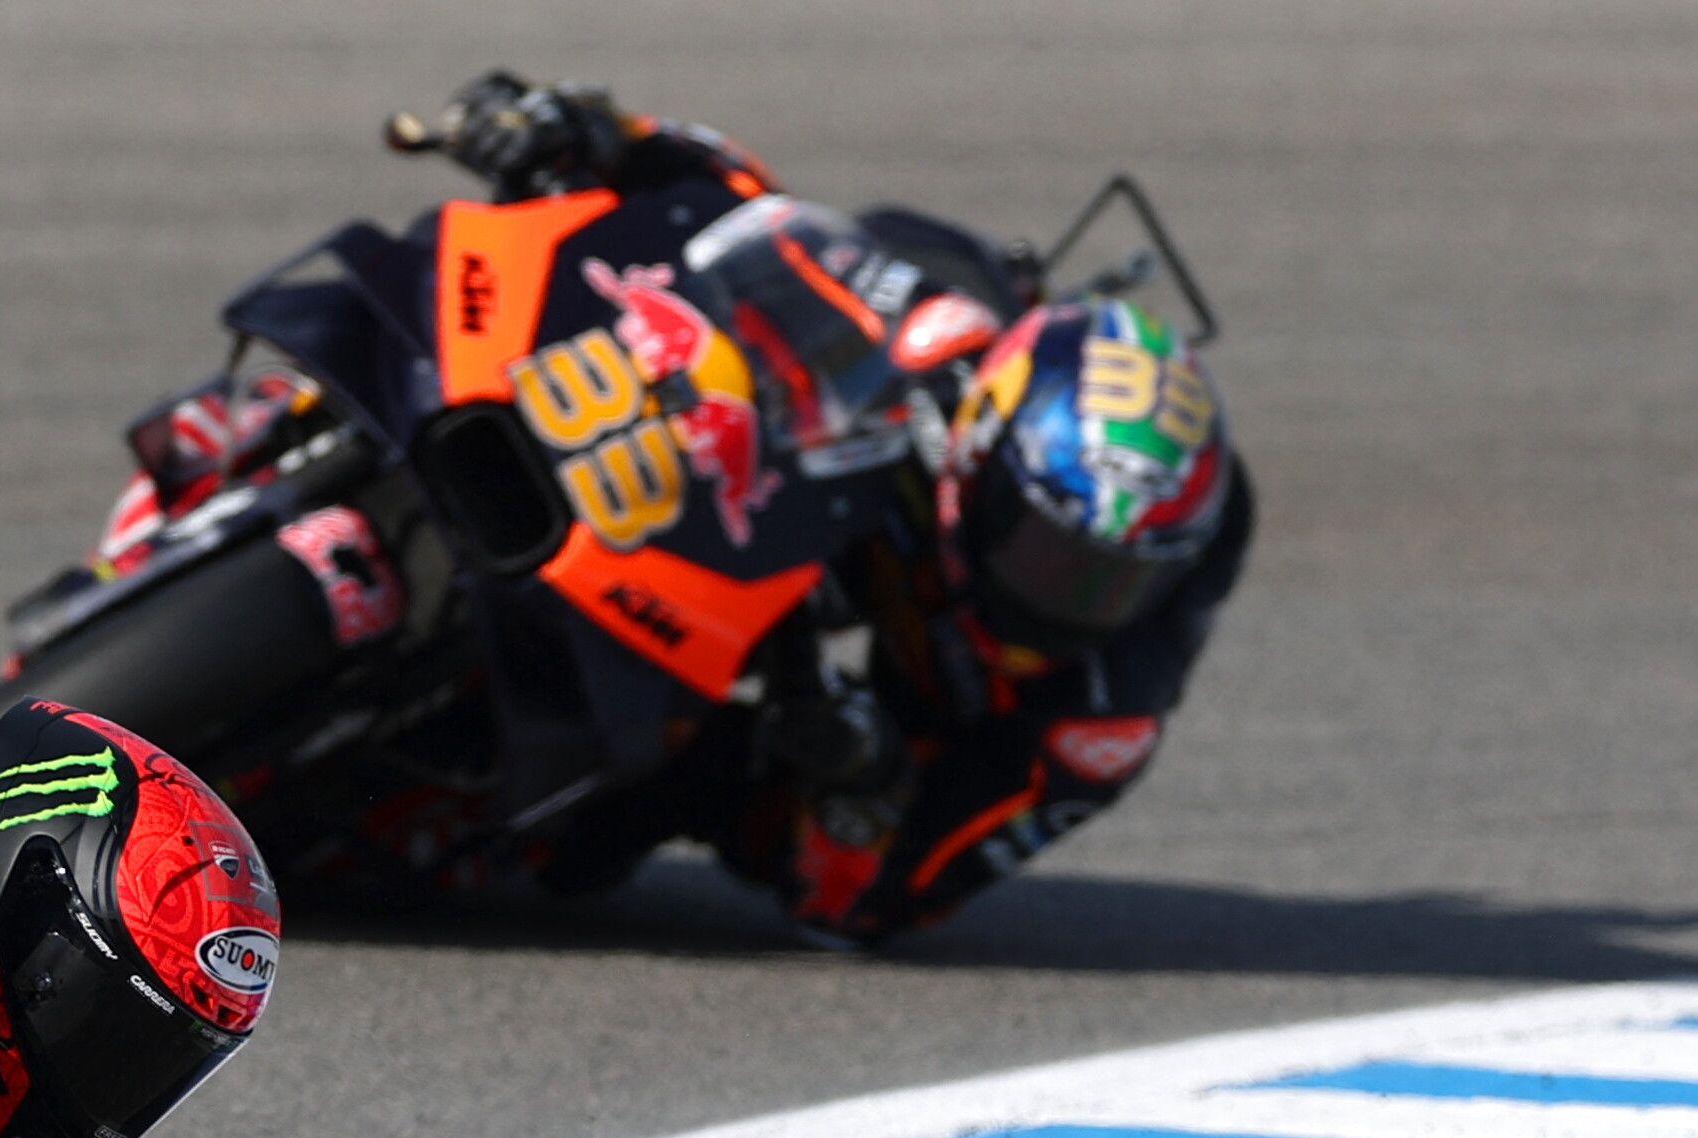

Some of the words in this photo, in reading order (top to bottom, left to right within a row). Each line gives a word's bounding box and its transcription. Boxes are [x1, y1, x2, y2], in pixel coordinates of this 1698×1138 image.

[508, 327, 686, 552] 33
[77, 912, 118, 960] SUOMY
[130, 975, 176, 1015] CARRERA
